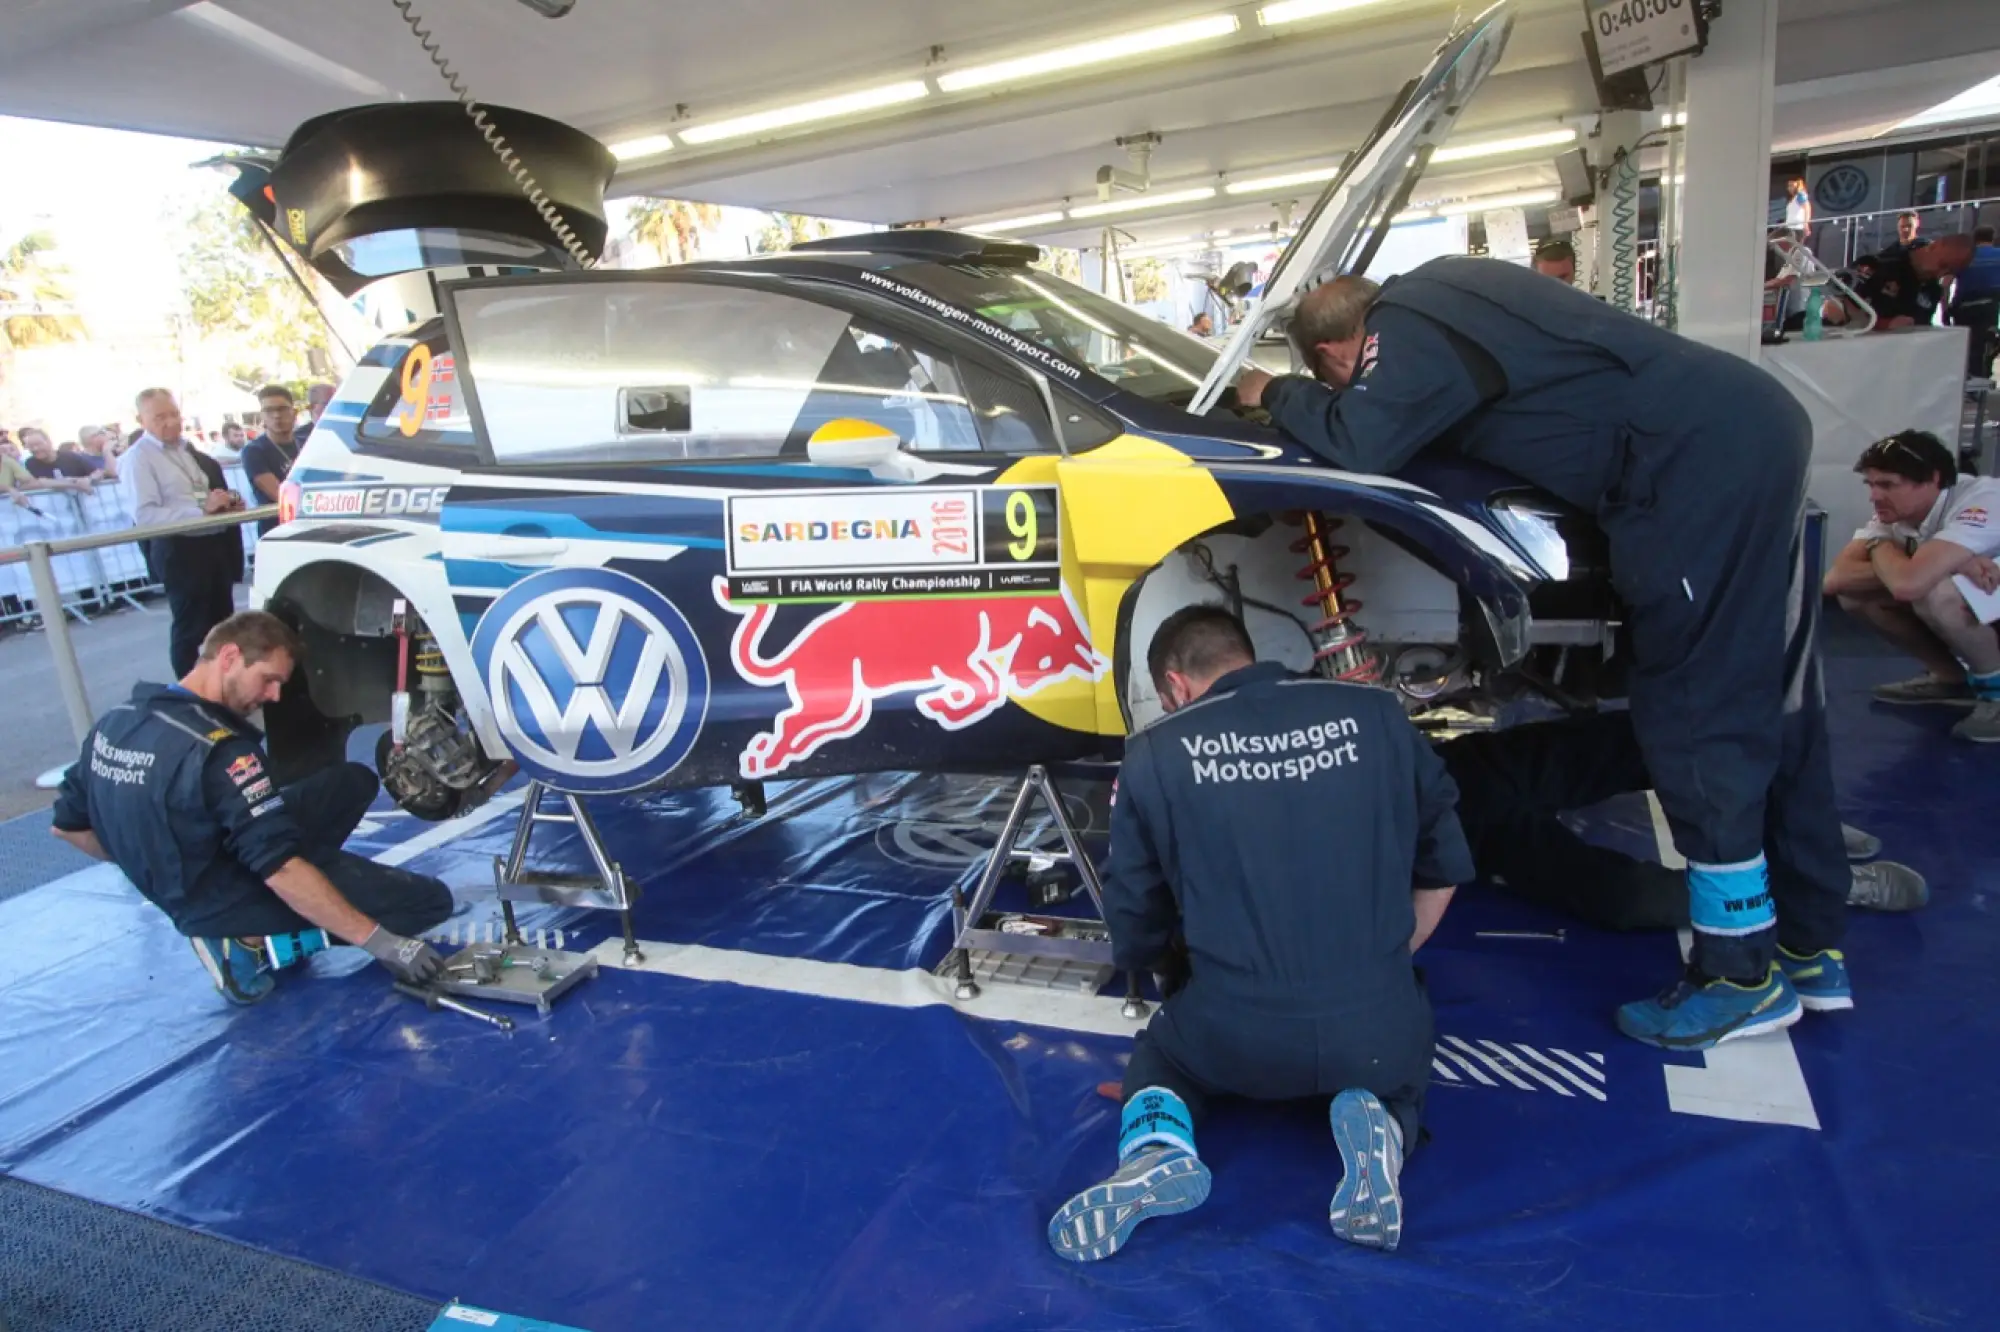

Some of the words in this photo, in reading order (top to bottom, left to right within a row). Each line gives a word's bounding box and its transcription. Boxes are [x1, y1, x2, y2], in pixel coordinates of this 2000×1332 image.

[861, 271, 1081, 380] www.volkswagen-motorsport.com
[400, 343, 431, 437] 9
[314, 492, 361, 513] Castrol
[363, 487, 451, 514] EDGE
[739, 519, 921, 543] SARDEGNA
[931, 499, 968, 555] 2016
[1005, 490, 1037, 562] 9
[790, 580, 811, 592] FIA
[814, 579, 852, 591] World
[855, 577, 888, 593] Rally
[891, 575, 981, 592] Championship
[1181, 717, 1359, 757] Volkswagen
[1192, 741, 1359, 785] Motorsport
